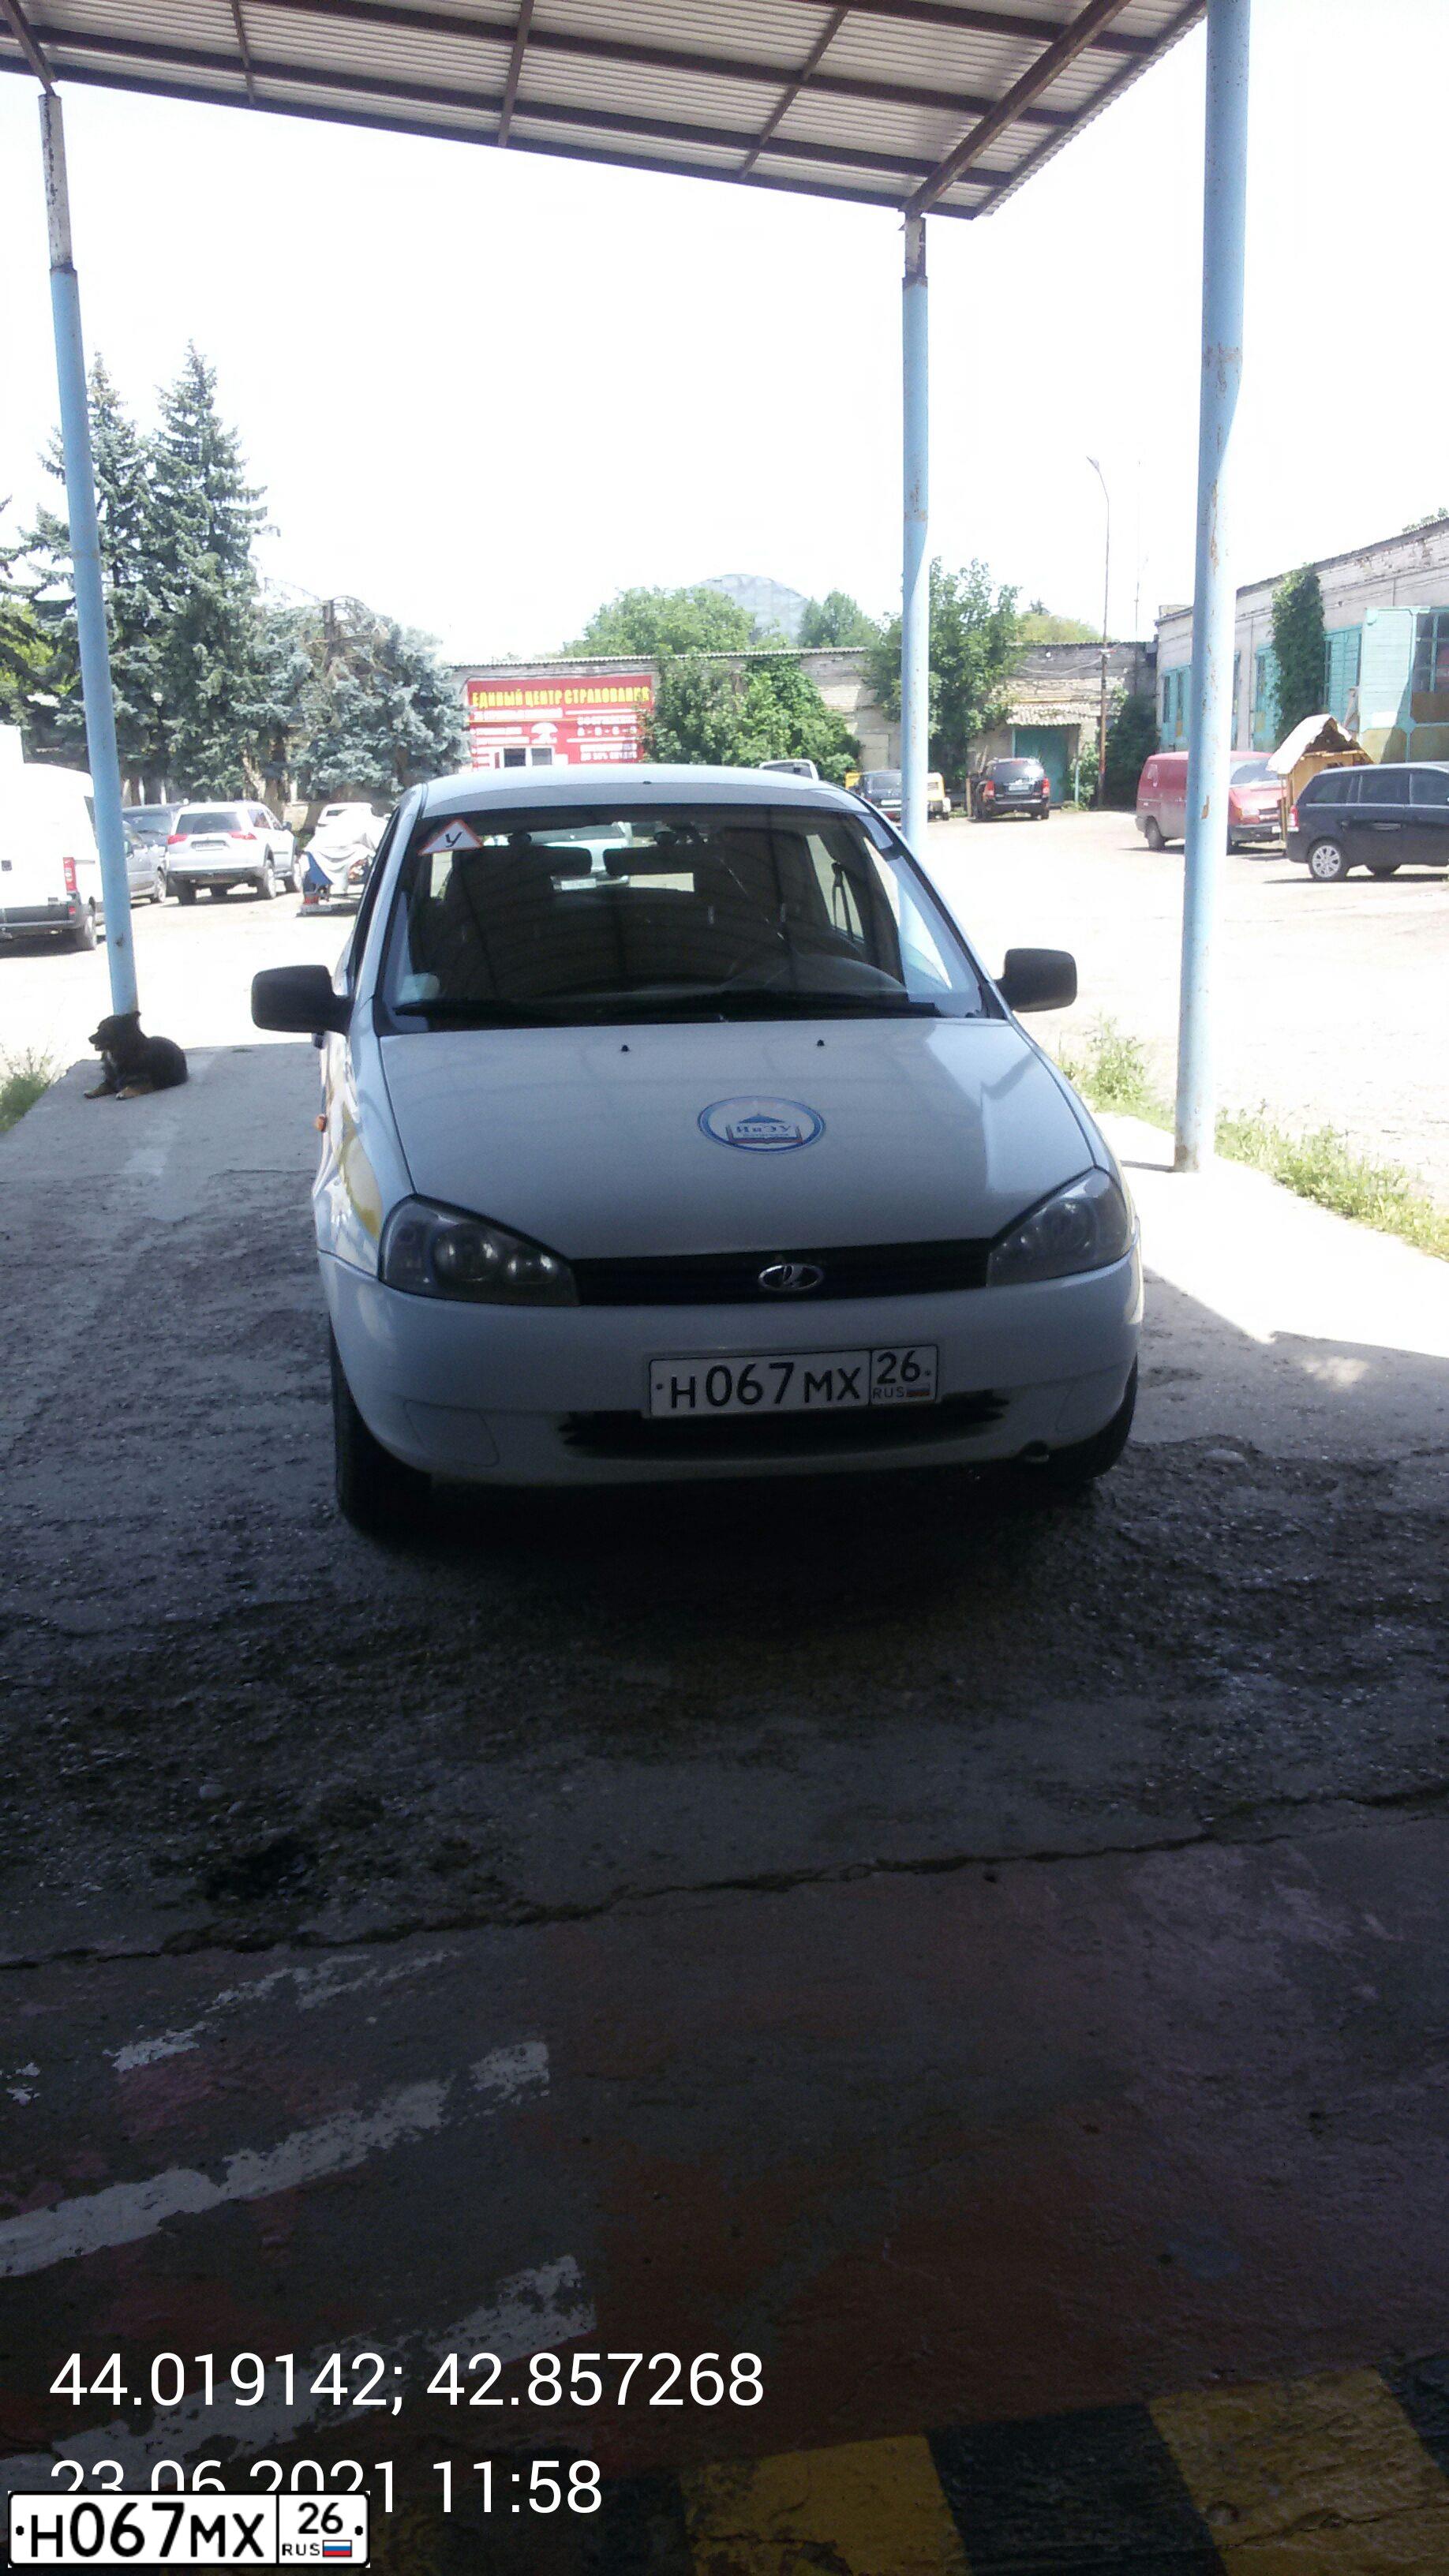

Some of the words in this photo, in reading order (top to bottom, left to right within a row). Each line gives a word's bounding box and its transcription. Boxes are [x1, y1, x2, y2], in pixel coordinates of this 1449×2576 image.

[472, 688, 523, 710] ЕДИНЫЙ
[525, 689, 563, 707] ЦЕНТР
[564, 686, 650, 705] СТРАХОВАНИЯ
[876, 1350, 921, 1384] 26
[872, 1386, 905, 1399] RUS
